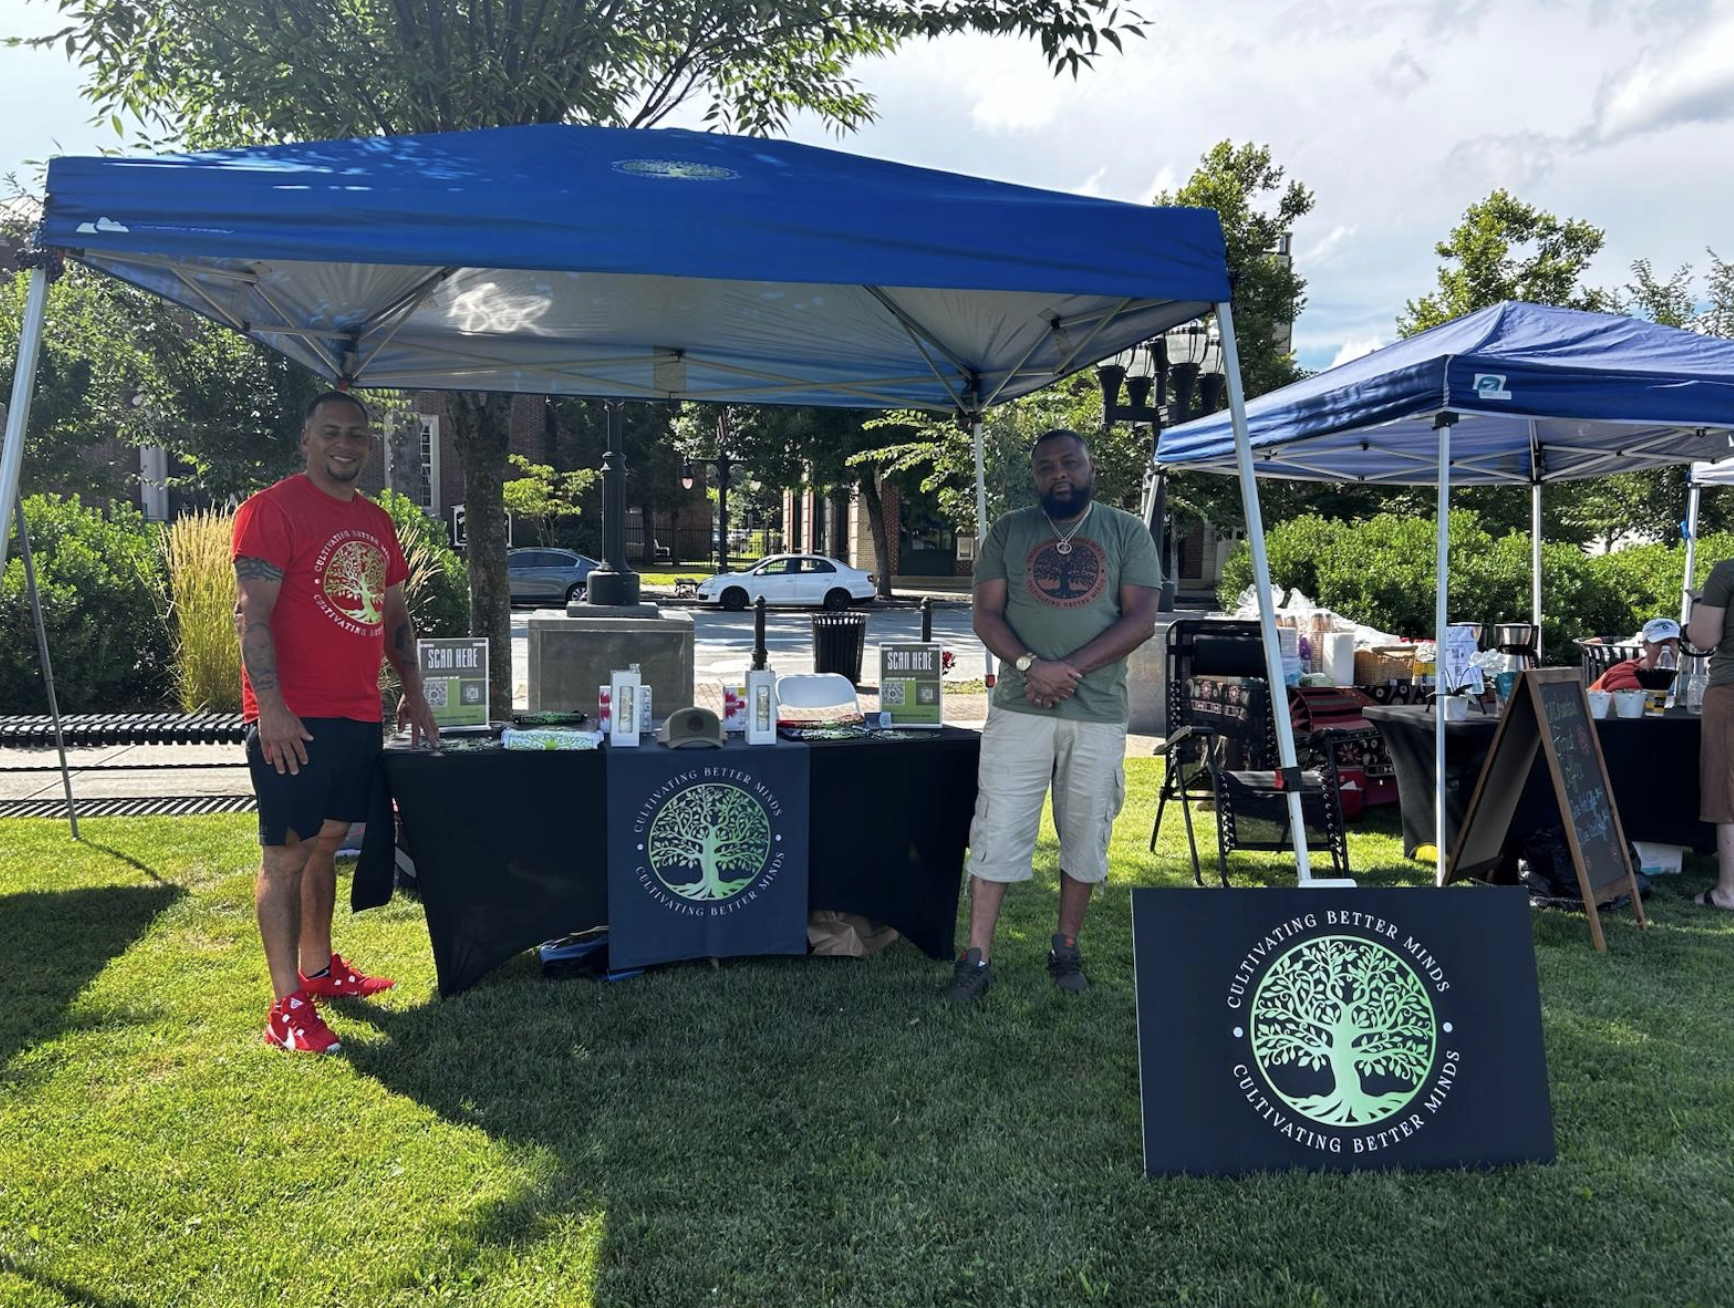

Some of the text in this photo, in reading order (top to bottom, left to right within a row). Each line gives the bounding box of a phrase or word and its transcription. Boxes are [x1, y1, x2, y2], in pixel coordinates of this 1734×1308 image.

[313, 594, 367, 636] CULTIVATING
[427, 648, 478, 669] SCAN HERE
[887, 652, 933, 670] SCAN HERE
[634, 767, 783, 833] CULTIVATING BETTER MINDS
[635, 852, 785, 917] CULTIVATING BETTER MINDS
[1227, 910, 1451, 1009] CULTIVATING BETTER MINDS
[1233, 1050, 1460, 1154] CULTIVATING BETTER MINDS
